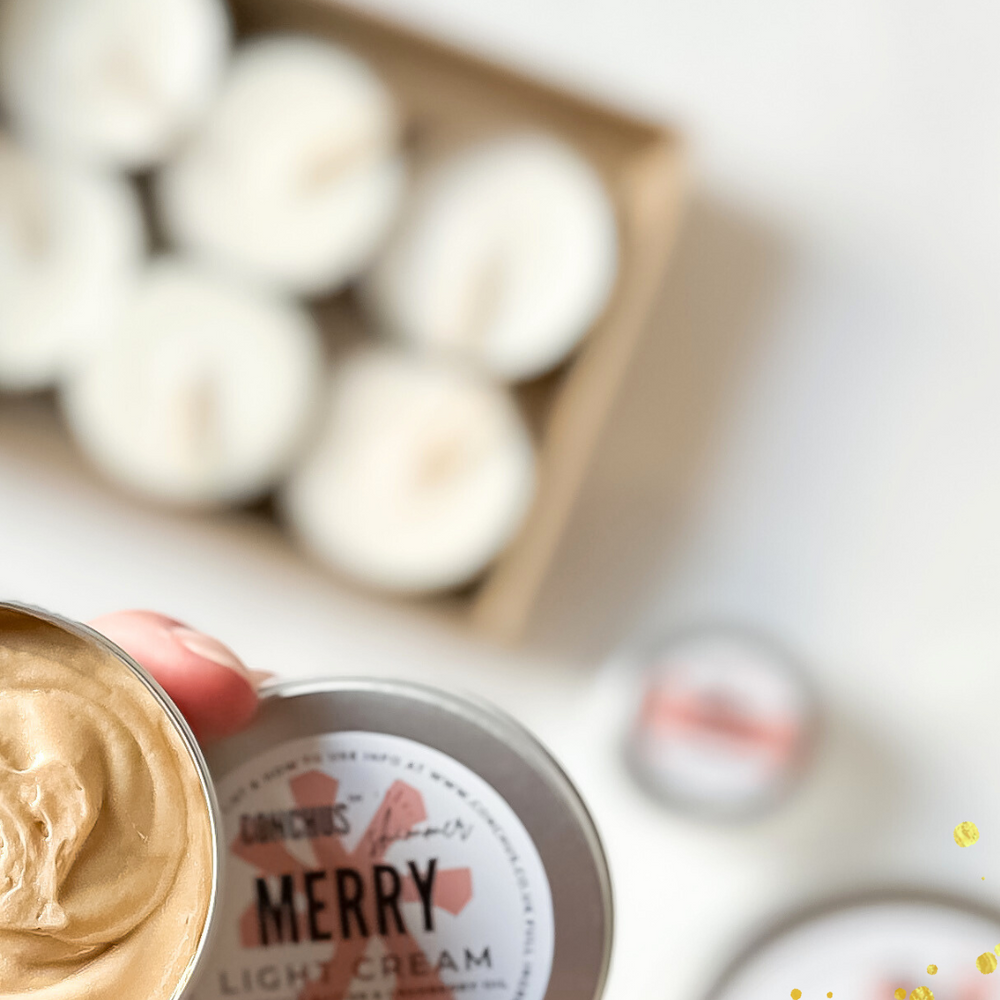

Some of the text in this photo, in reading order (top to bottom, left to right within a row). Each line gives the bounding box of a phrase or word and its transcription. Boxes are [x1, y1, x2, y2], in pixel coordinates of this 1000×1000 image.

[255, 857, 440, 947] MERRY
[217, 946, 493, 996] LIGHT CREAM
